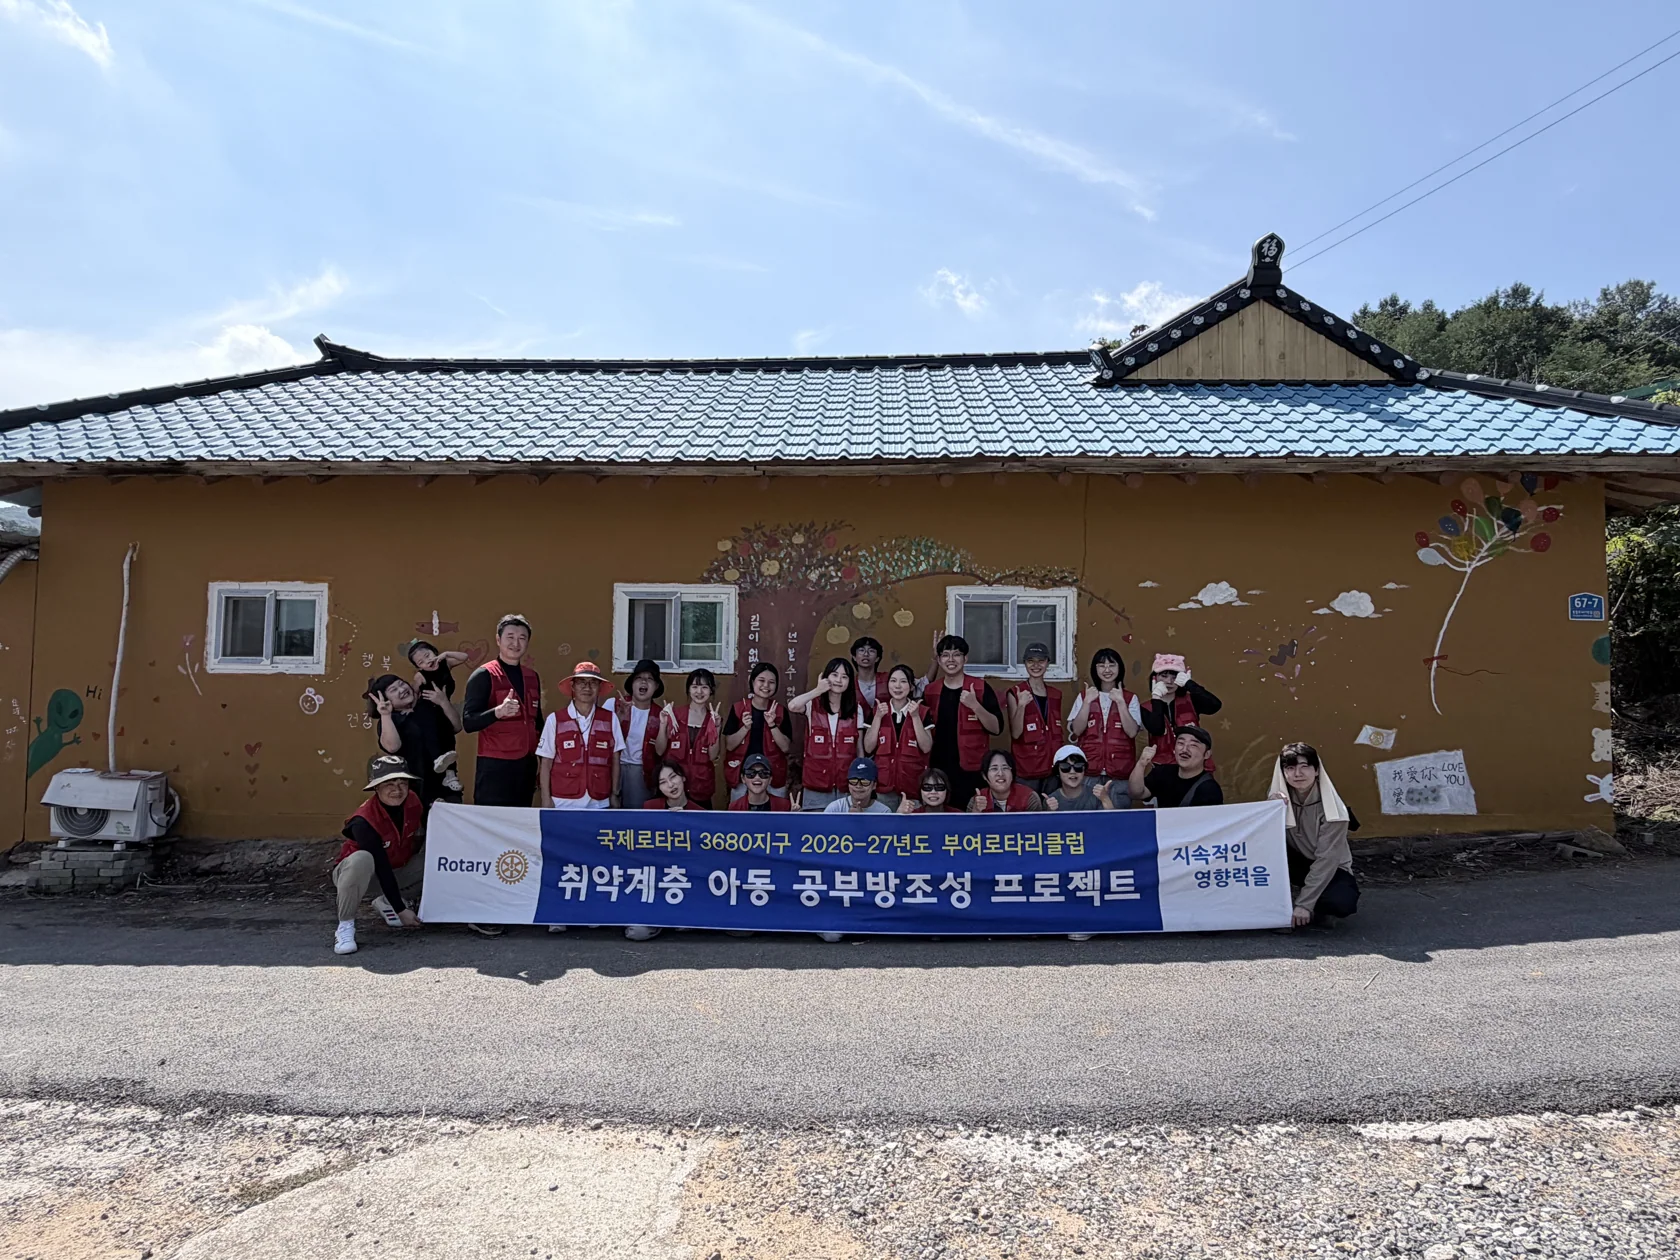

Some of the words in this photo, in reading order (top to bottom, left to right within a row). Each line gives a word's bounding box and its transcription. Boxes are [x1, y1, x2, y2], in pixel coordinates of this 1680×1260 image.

[1261, 238, 1278, 257] 福
[1574, 597, 1599, 608] 67-7
[748, 613, 760, 642] 길이
[85, 685, 103, 700] Hi
[1441, 762, 1465, 773] LOVE
[1443, 774, 1466, 786] YOU
[597, 829, 691, 851] 국제로타리
[700, 832, 791, 854] 3680지구
[800, 834, 932, 856] 2026-27년도
[942, 832, 1085, 856] 부여로타리클럽
[1172, 841, 1248, 866] 지속적인
[437, 856, 491, 876] Rotary
[558, 864, 692, 905] 취약계층
[708, 868, 776, 906] 아동
[792, 870, 972, 909] 공부방조성
[991, 869, 1141, 906] 프로젝트
[1194, 865, 1271, 889] 영향력을
